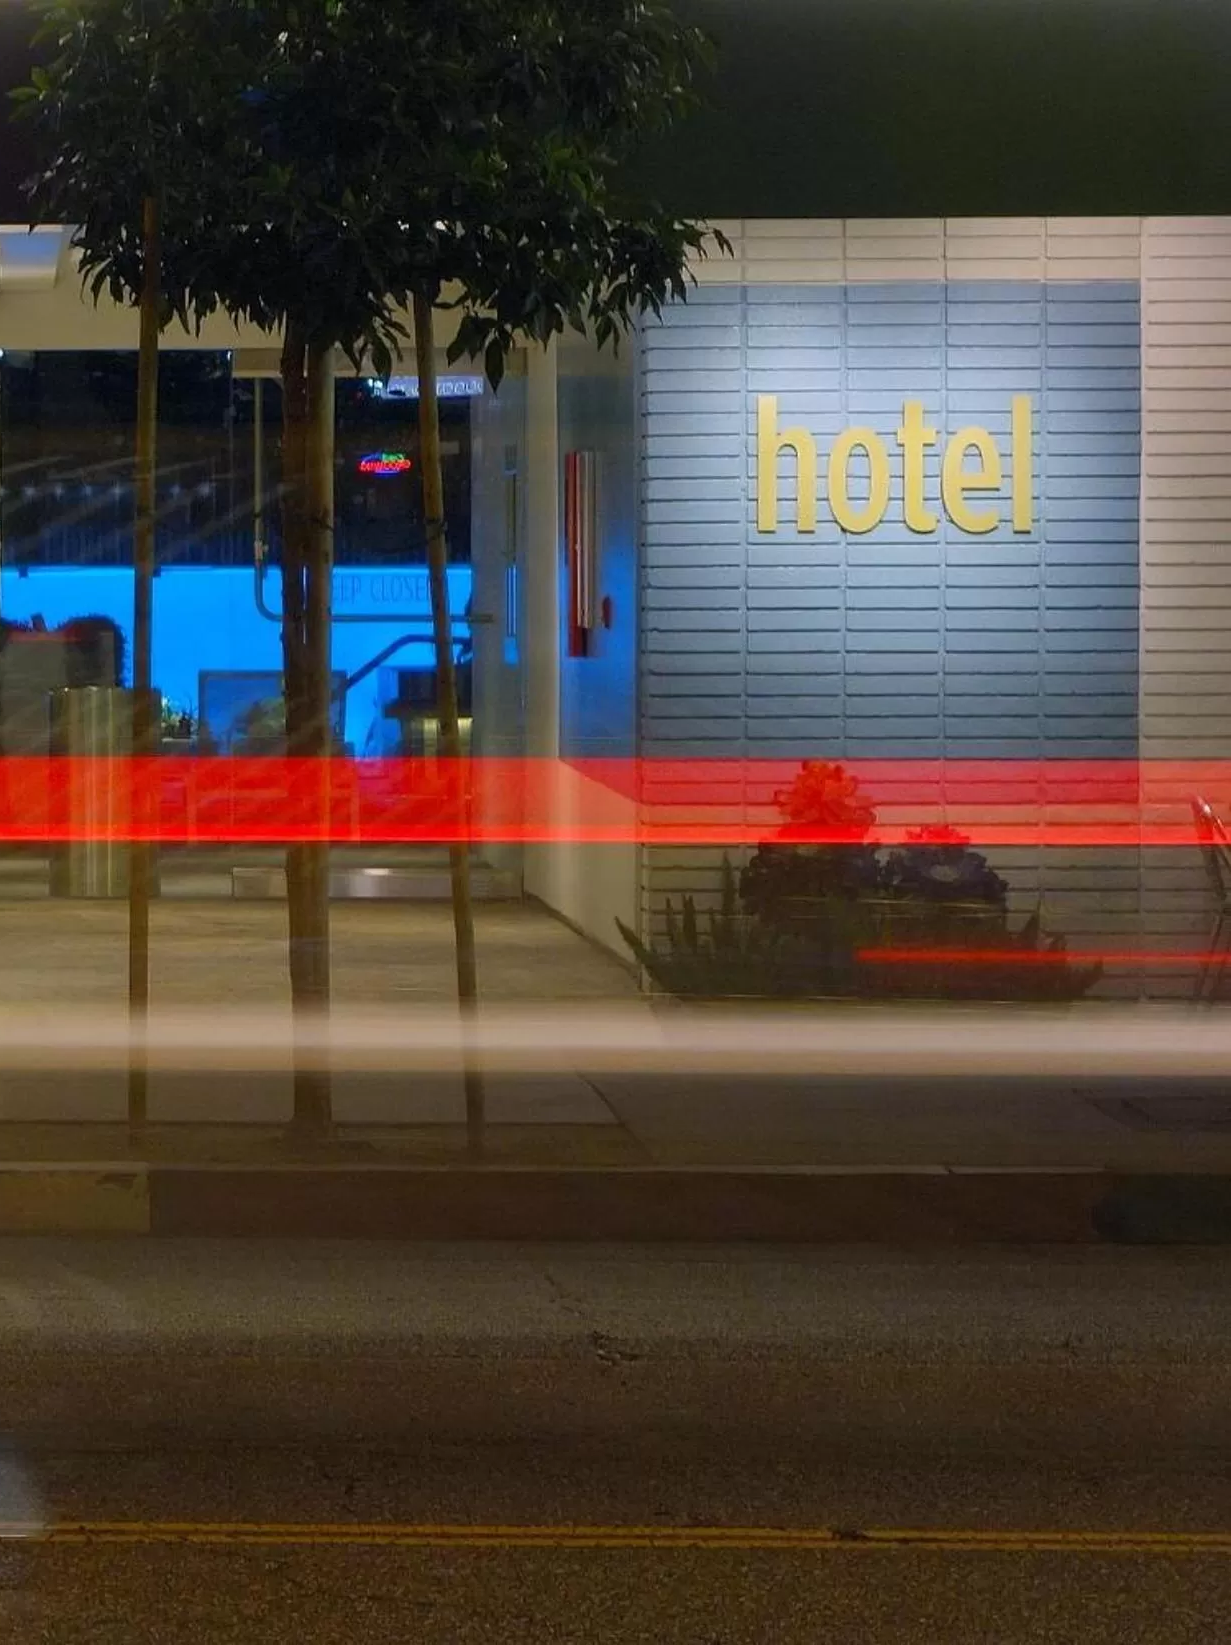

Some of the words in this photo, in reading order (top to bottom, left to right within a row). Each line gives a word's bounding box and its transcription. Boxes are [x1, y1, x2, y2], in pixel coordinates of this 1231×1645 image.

[756, 394, 1033, 534] hotel
[331, 575, 362, 603] EEP
[370, 575, 432, 602] CLOSE
